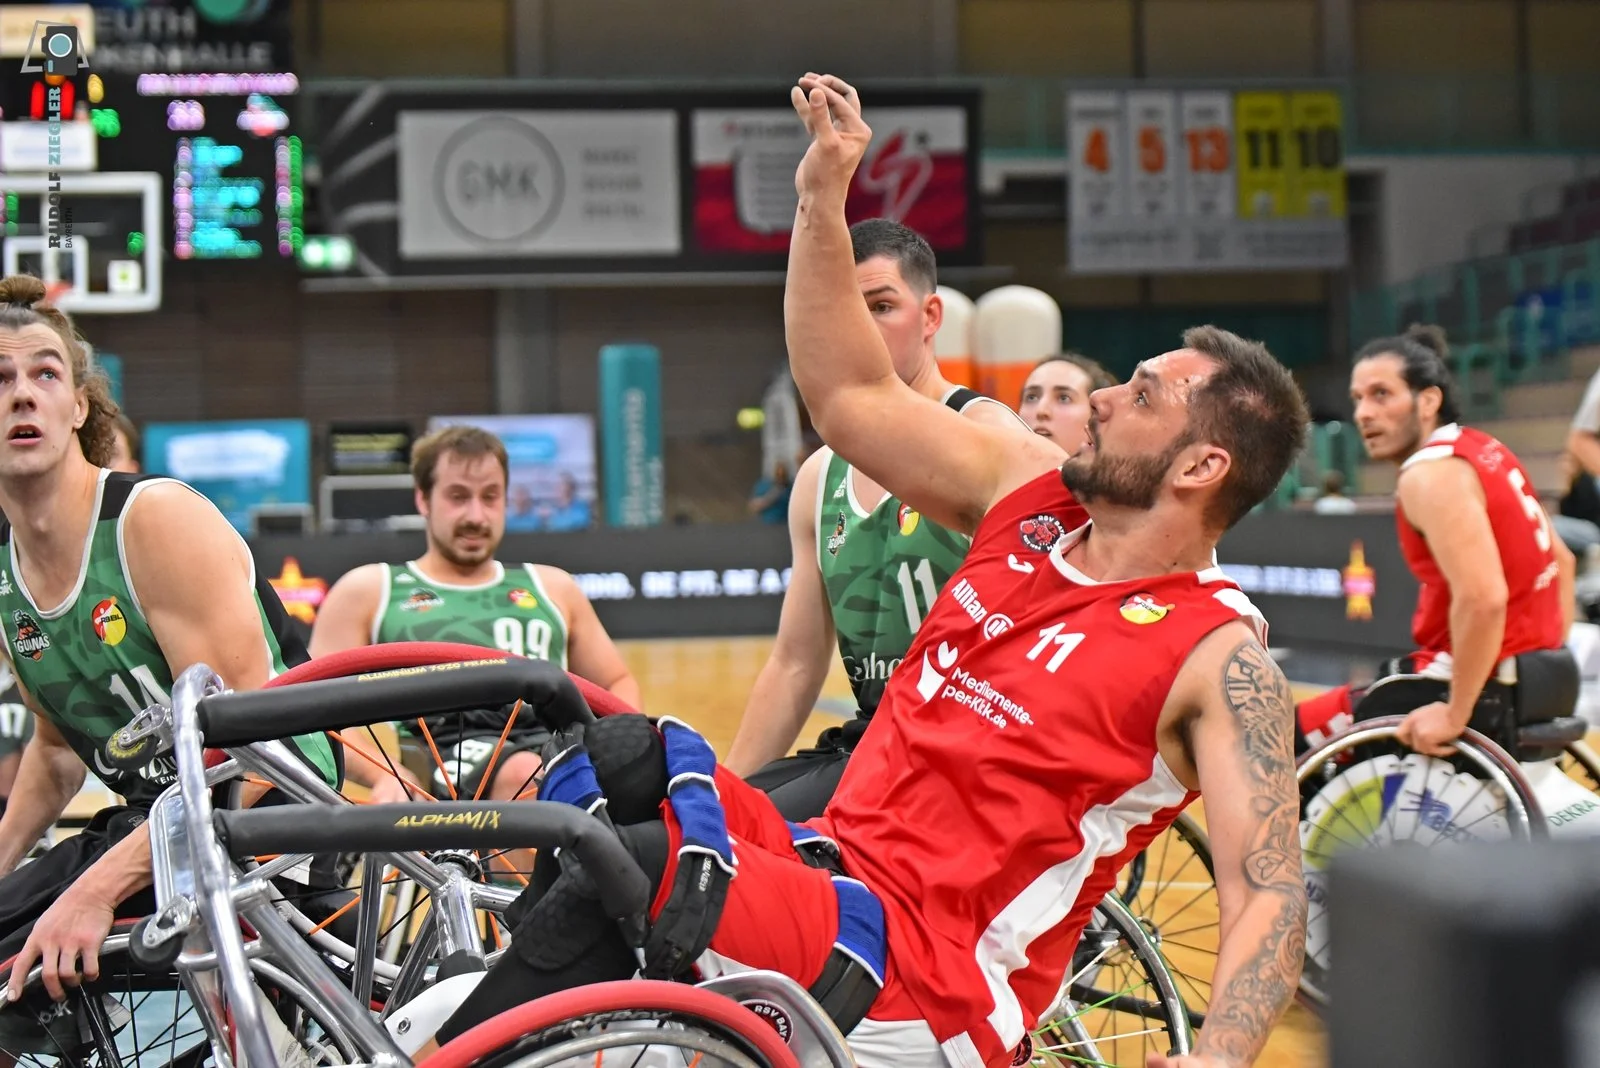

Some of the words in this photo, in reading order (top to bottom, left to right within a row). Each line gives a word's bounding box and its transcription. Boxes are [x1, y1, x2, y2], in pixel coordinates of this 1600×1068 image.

[1083, 126, 1111, 173] 4
[1138, 125, 1167, 173] 5
[1185, 126, 1230, 174] 13
[1246, 129, 1285, 169] 11
[1294, 126, 1341, 169] 10
[897, 558, 938, 635] 11
[494, 617, 551, 661] 99
[1026, 621, 1086, 674] 11
[1546, 799, 1600, 827] DEKRA
[754, 1005, 779, 1017] RSV
